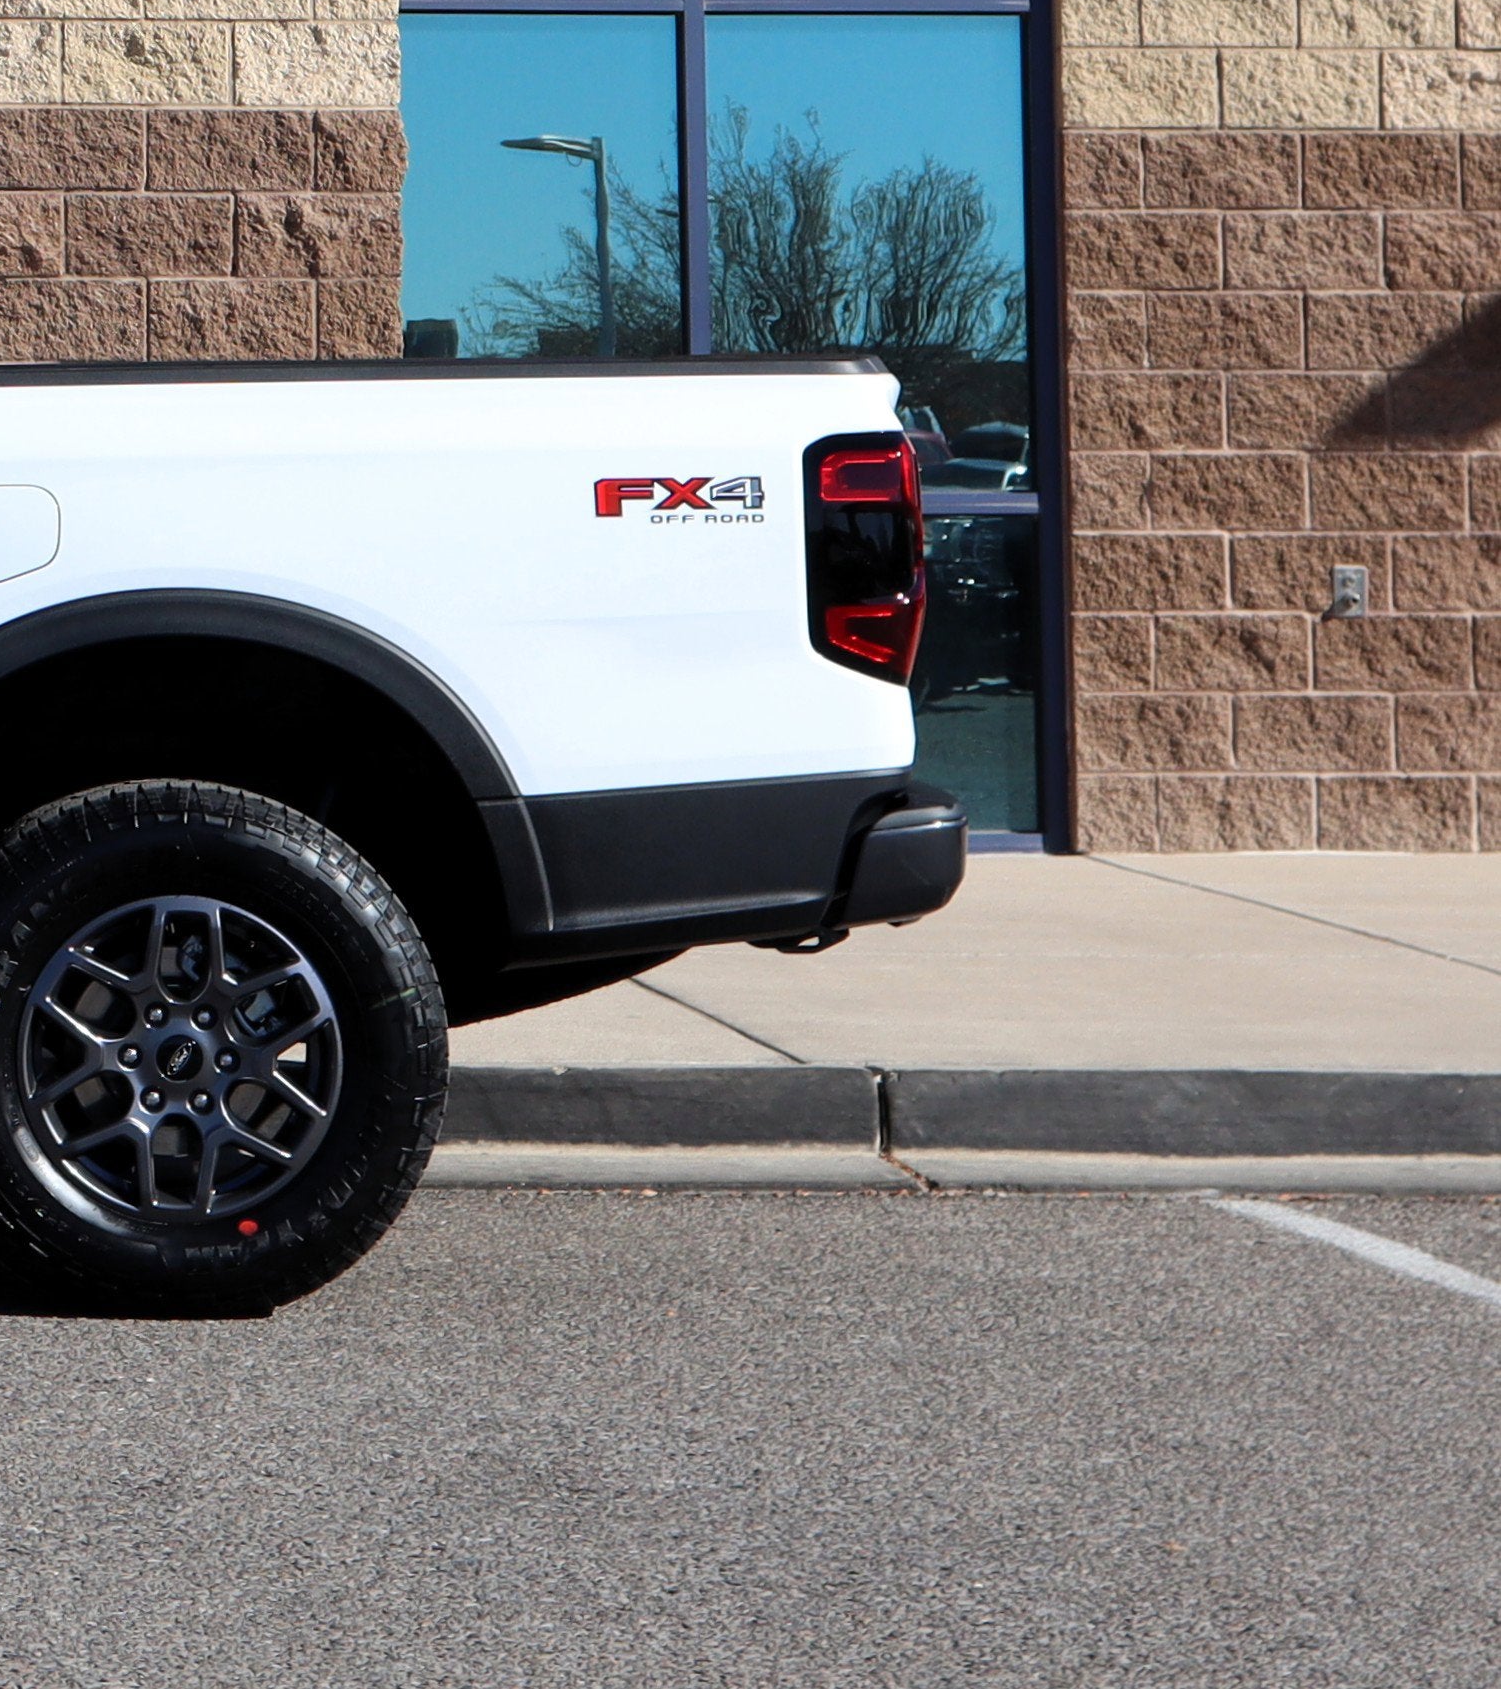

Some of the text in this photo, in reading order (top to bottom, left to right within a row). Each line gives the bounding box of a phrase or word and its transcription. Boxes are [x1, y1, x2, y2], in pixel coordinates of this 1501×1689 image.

[593, 476, 765, 517] FX4
[650, 514, 765, 524] OFF ROAD
